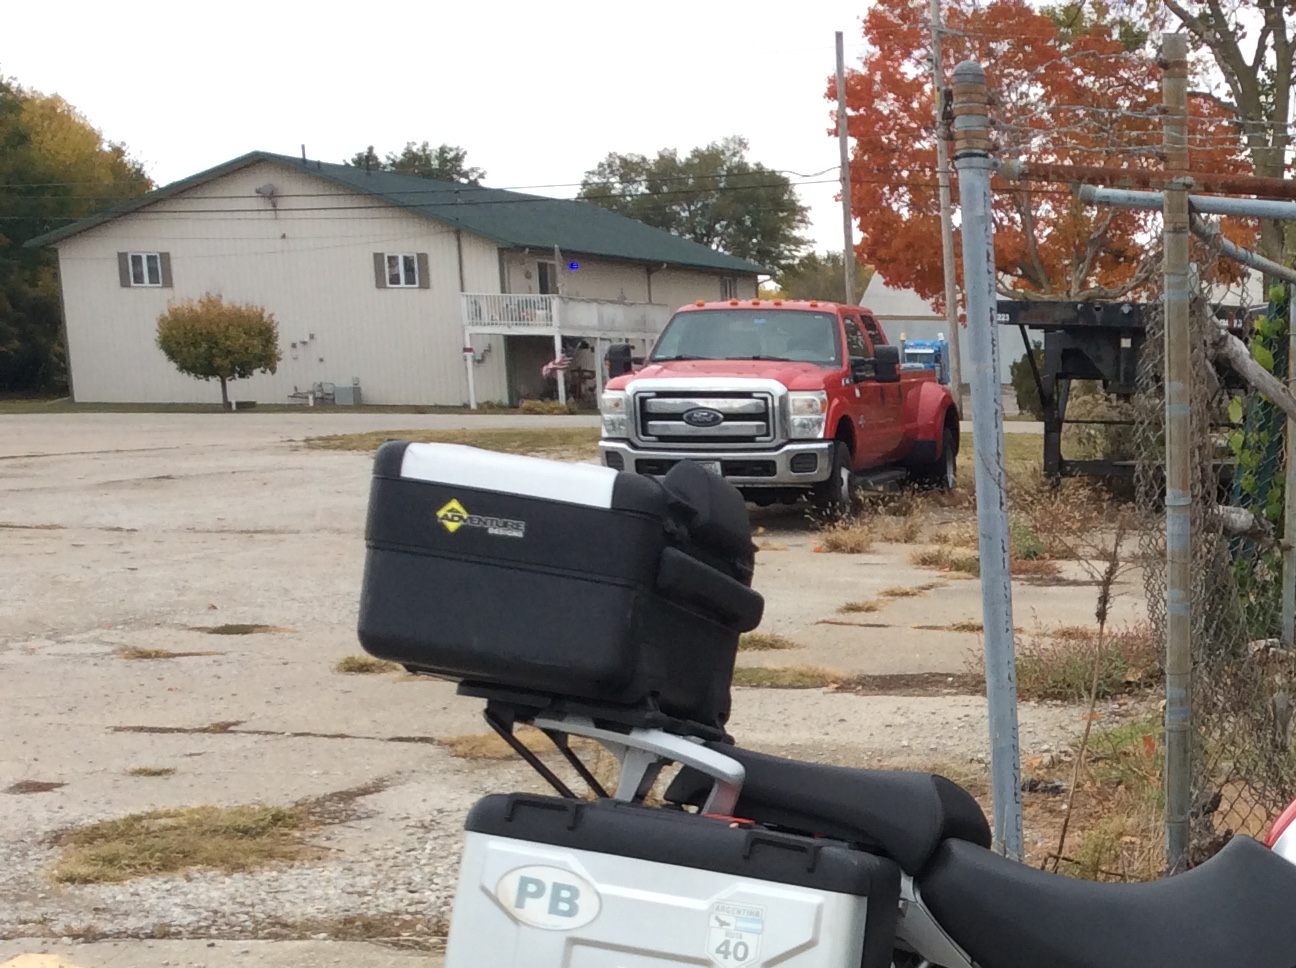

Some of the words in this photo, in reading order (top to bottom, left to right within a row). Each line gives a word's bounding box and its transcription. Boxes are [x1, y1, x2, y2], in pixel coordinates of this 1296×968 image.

[438, 510, 525, 532] ADVENTURE
[515, 876, 580, 917] PB
[714, 905, 761, 918] ARGENTINA
[715, 939, 749, 962] 40
